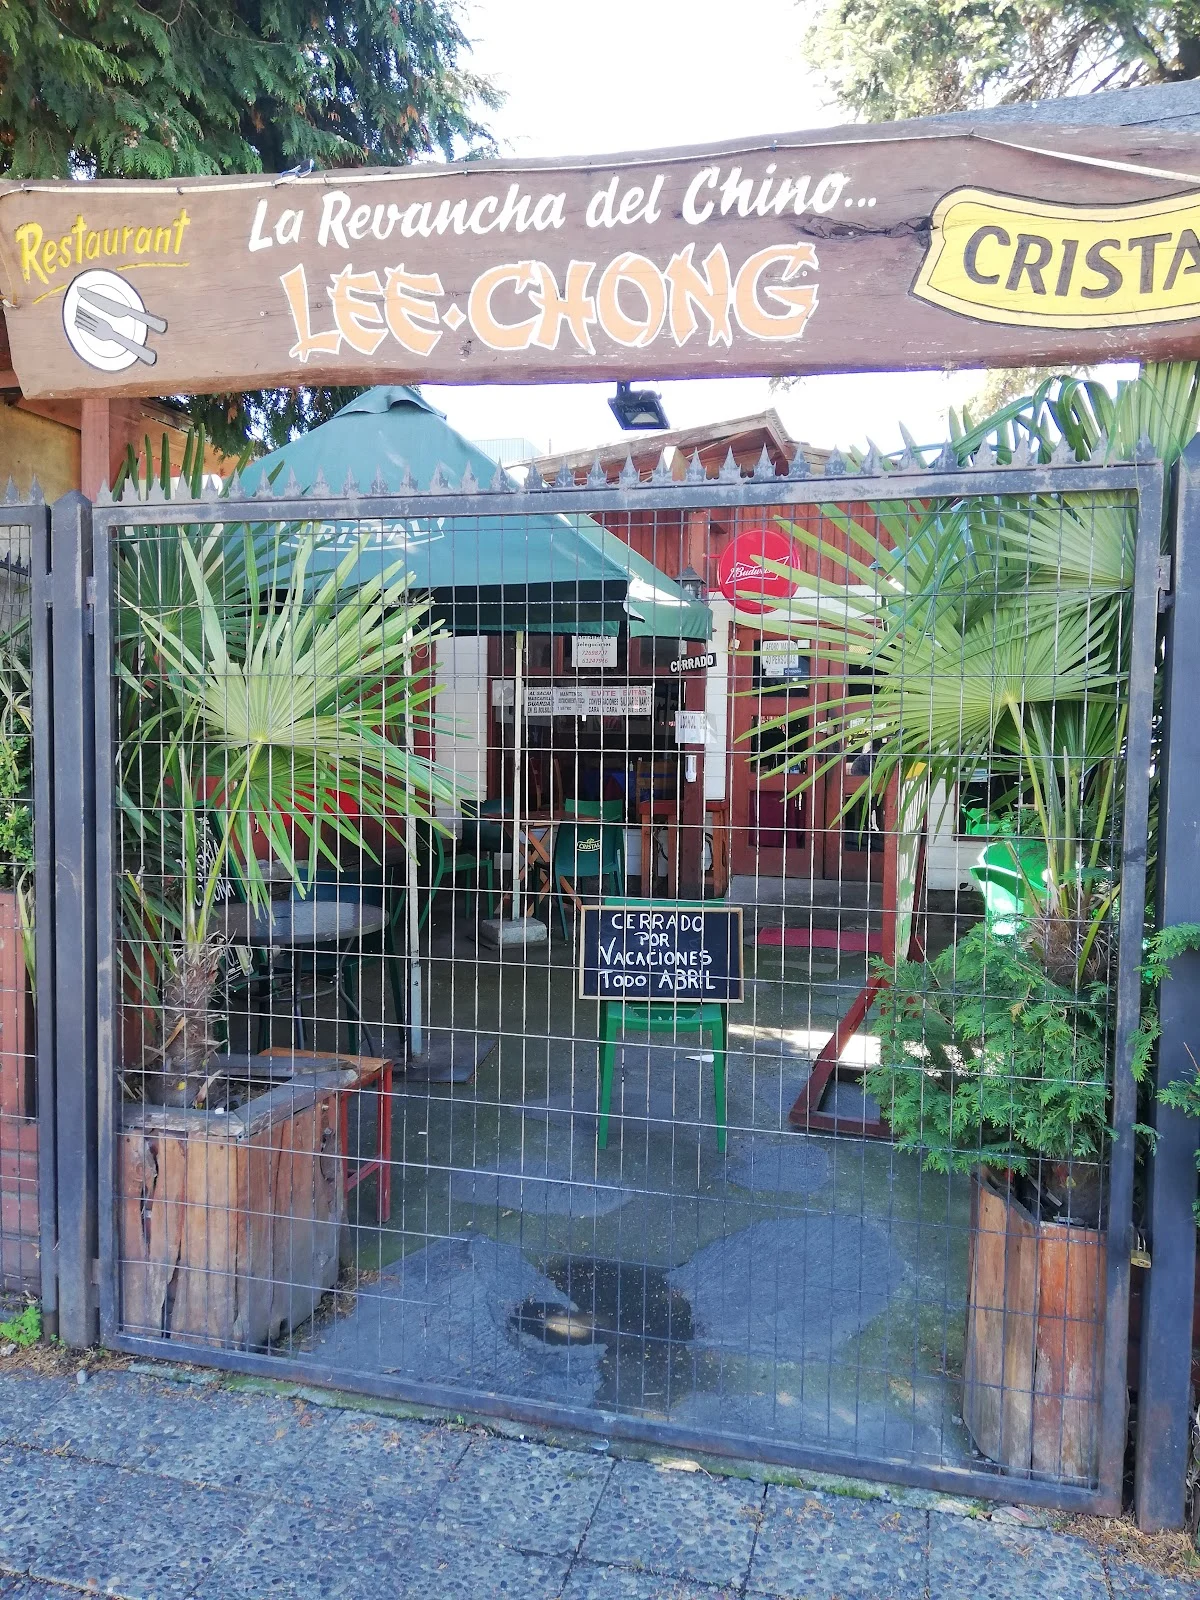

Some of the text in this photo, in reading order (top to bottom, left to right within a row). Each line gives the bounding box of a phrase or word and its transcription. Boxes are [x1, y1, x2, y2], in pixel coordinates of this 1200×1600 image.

[247, 198, 301, 253] La
[317, 183, 566, 250] Revancha
[585, 173, 664, 229] del
[15, 208, 191, 285] Restaurant
[670, 654, 714, 673] CERRADO
[578, 842, 600, 850] CRISTAL
[611, 913, 704, 933] CERRADO
[634, 931, 670, 948] POR
[658, 969, 716, 991] ABRIL
